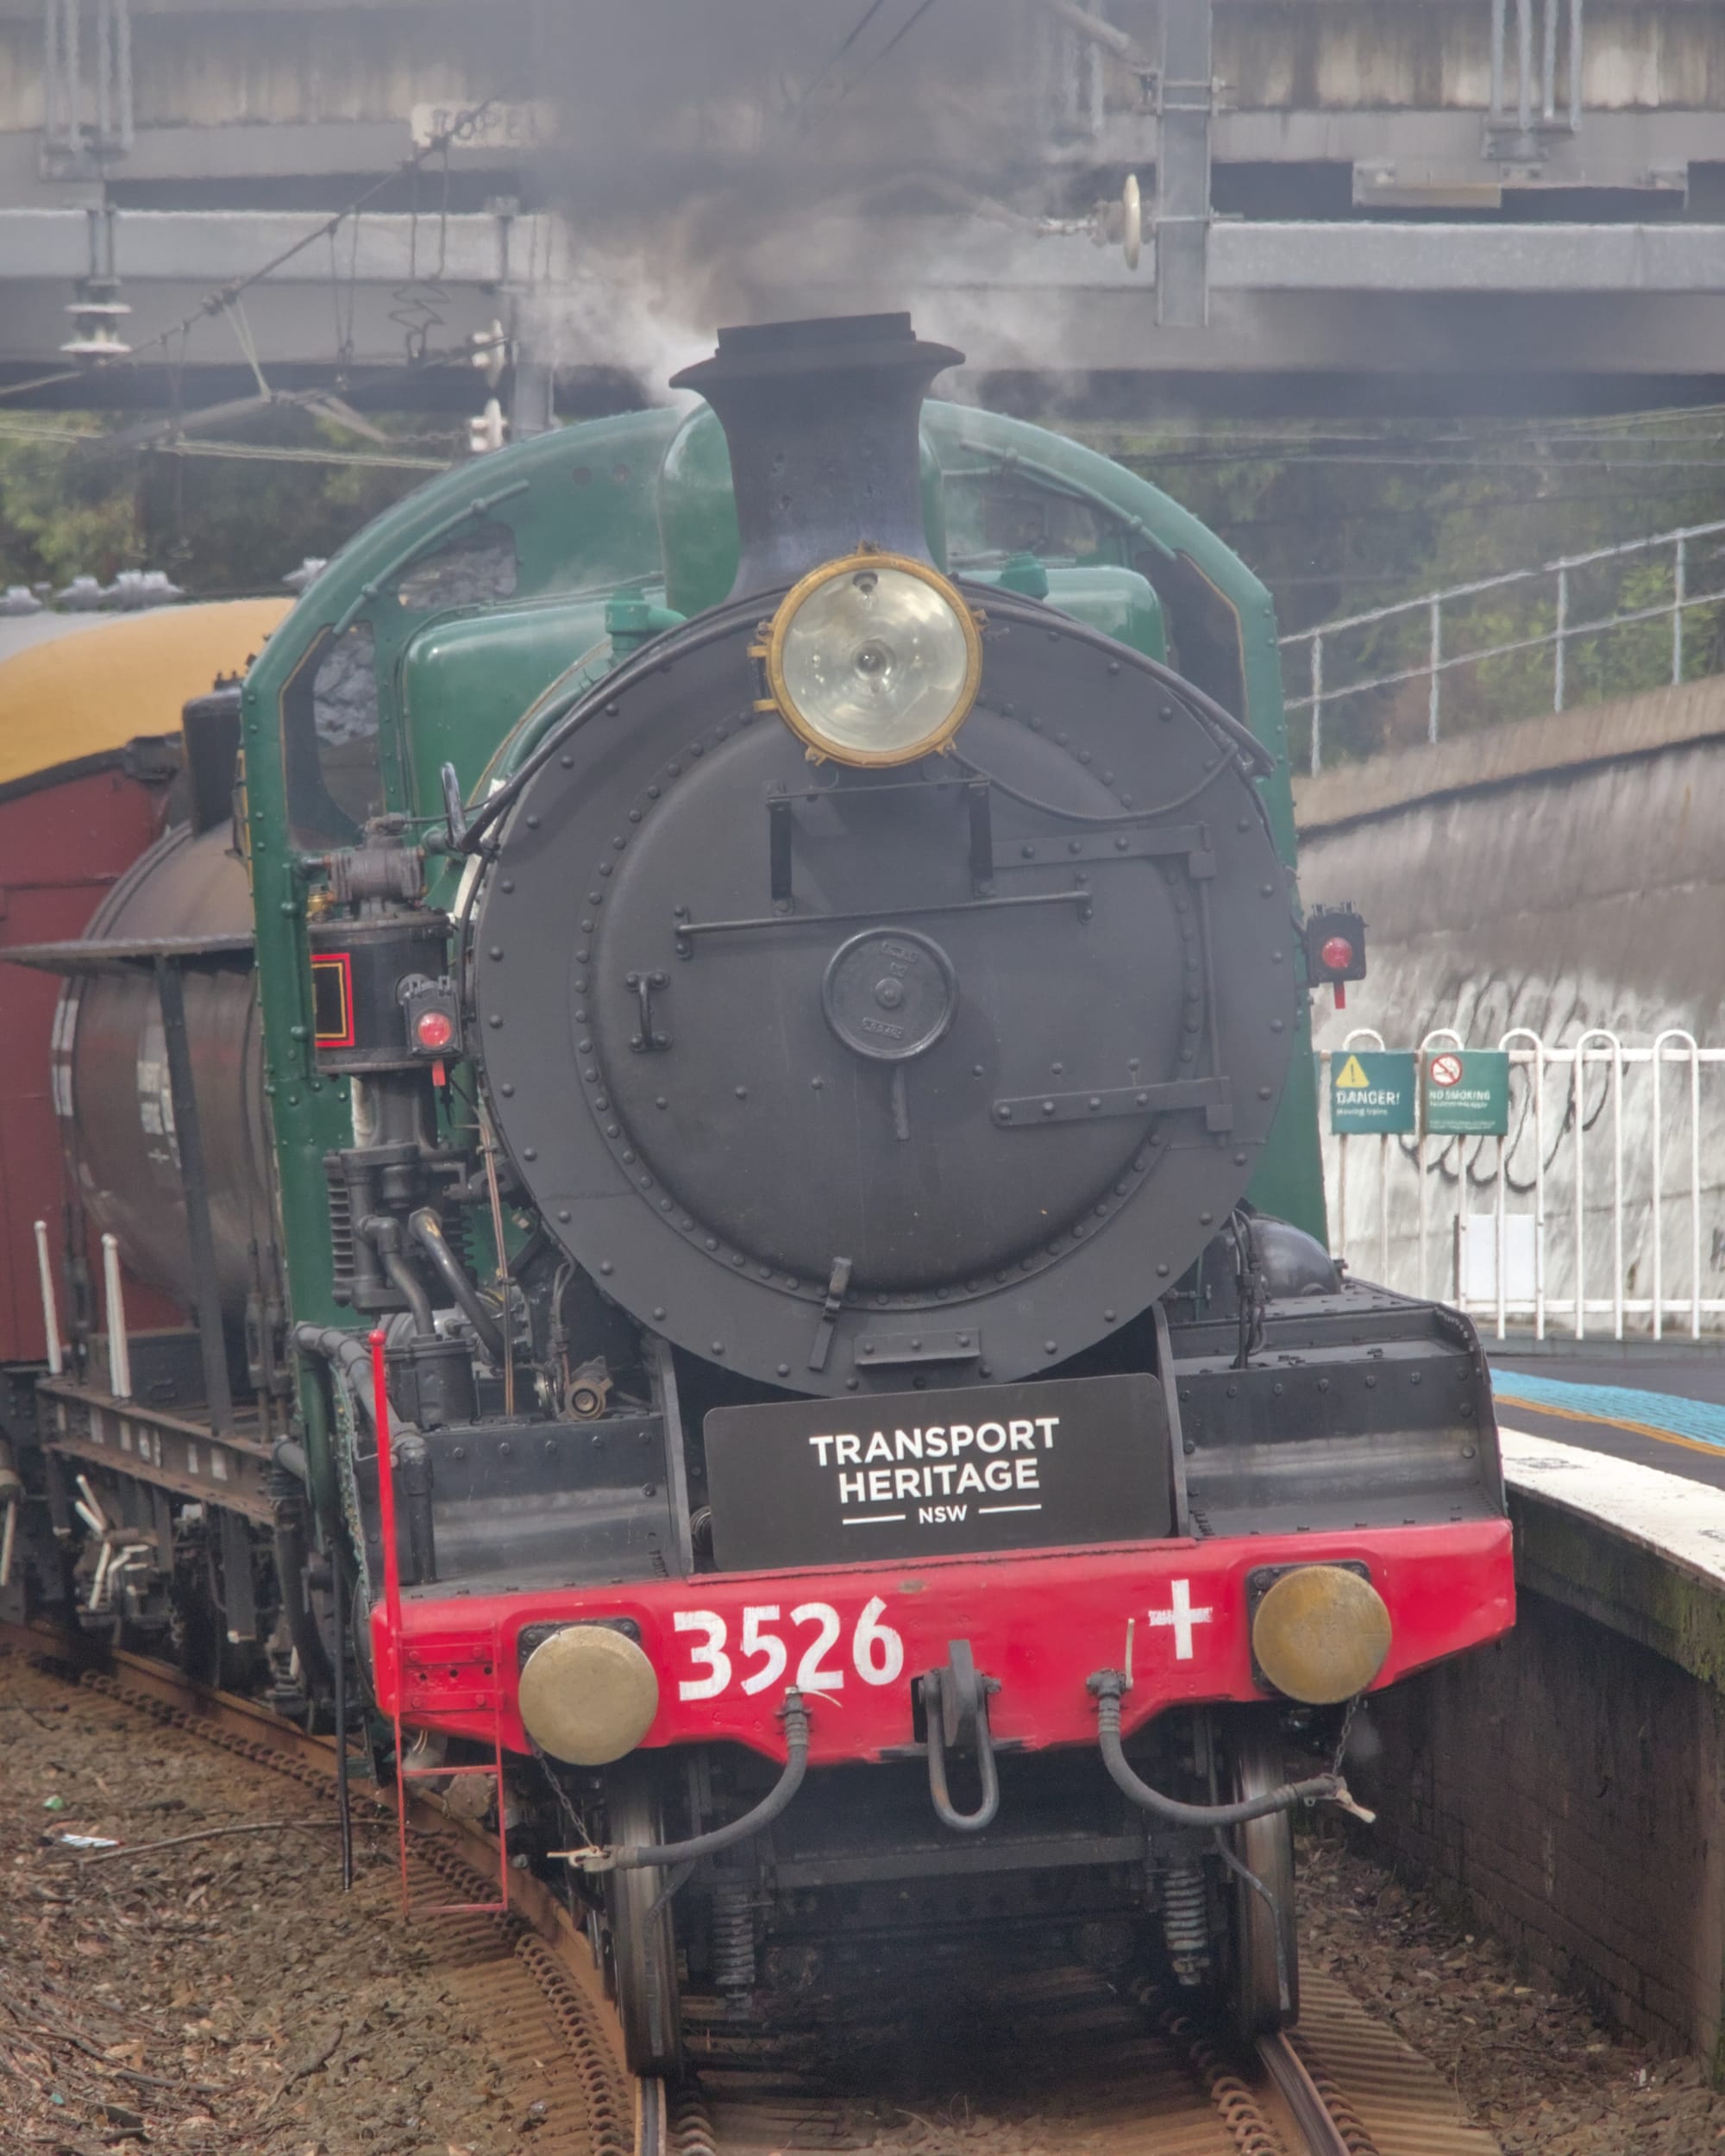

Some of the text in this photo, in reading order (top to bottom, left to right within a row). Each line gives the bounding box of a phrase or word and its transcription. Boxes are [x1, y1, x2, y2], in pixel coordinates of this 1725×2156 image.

[1336, 1089, 1401, 1105] DANGER!
[1428, 1089, 1490, 1100] NO SMOKING
[809, 1417, 1060, 1466] TRANSPORT
[838, 1457, 1040, 1504] HERITAGE
[919, 1505, 968, 1524] NSW
[673, 1595, 904, 1702] 3526
